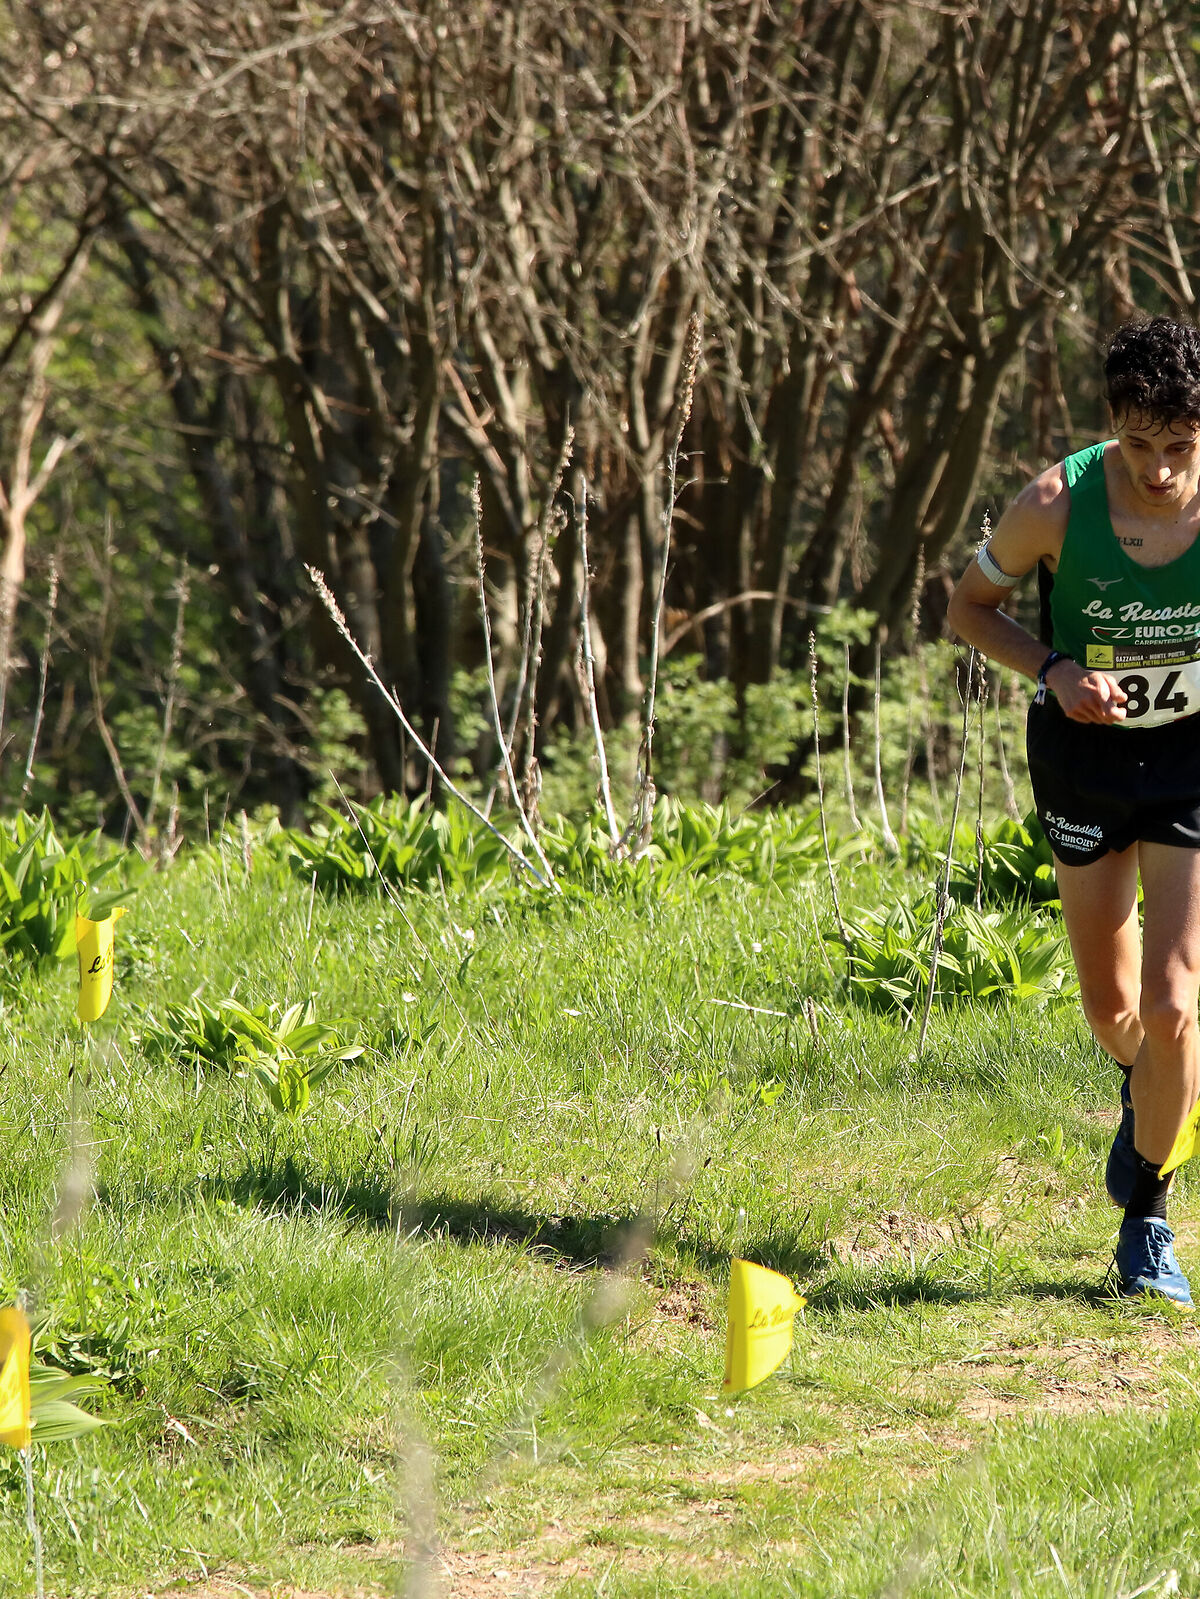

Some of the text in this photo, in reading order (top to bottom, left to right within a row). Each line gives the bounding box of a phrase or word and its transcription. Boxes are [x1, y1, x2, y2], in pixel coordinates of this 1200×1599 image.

[1082, 600, 1113, 620] La
[1117, 670, 1188, 719] 84
[1045, 811, 1103, 839] La Recastello
